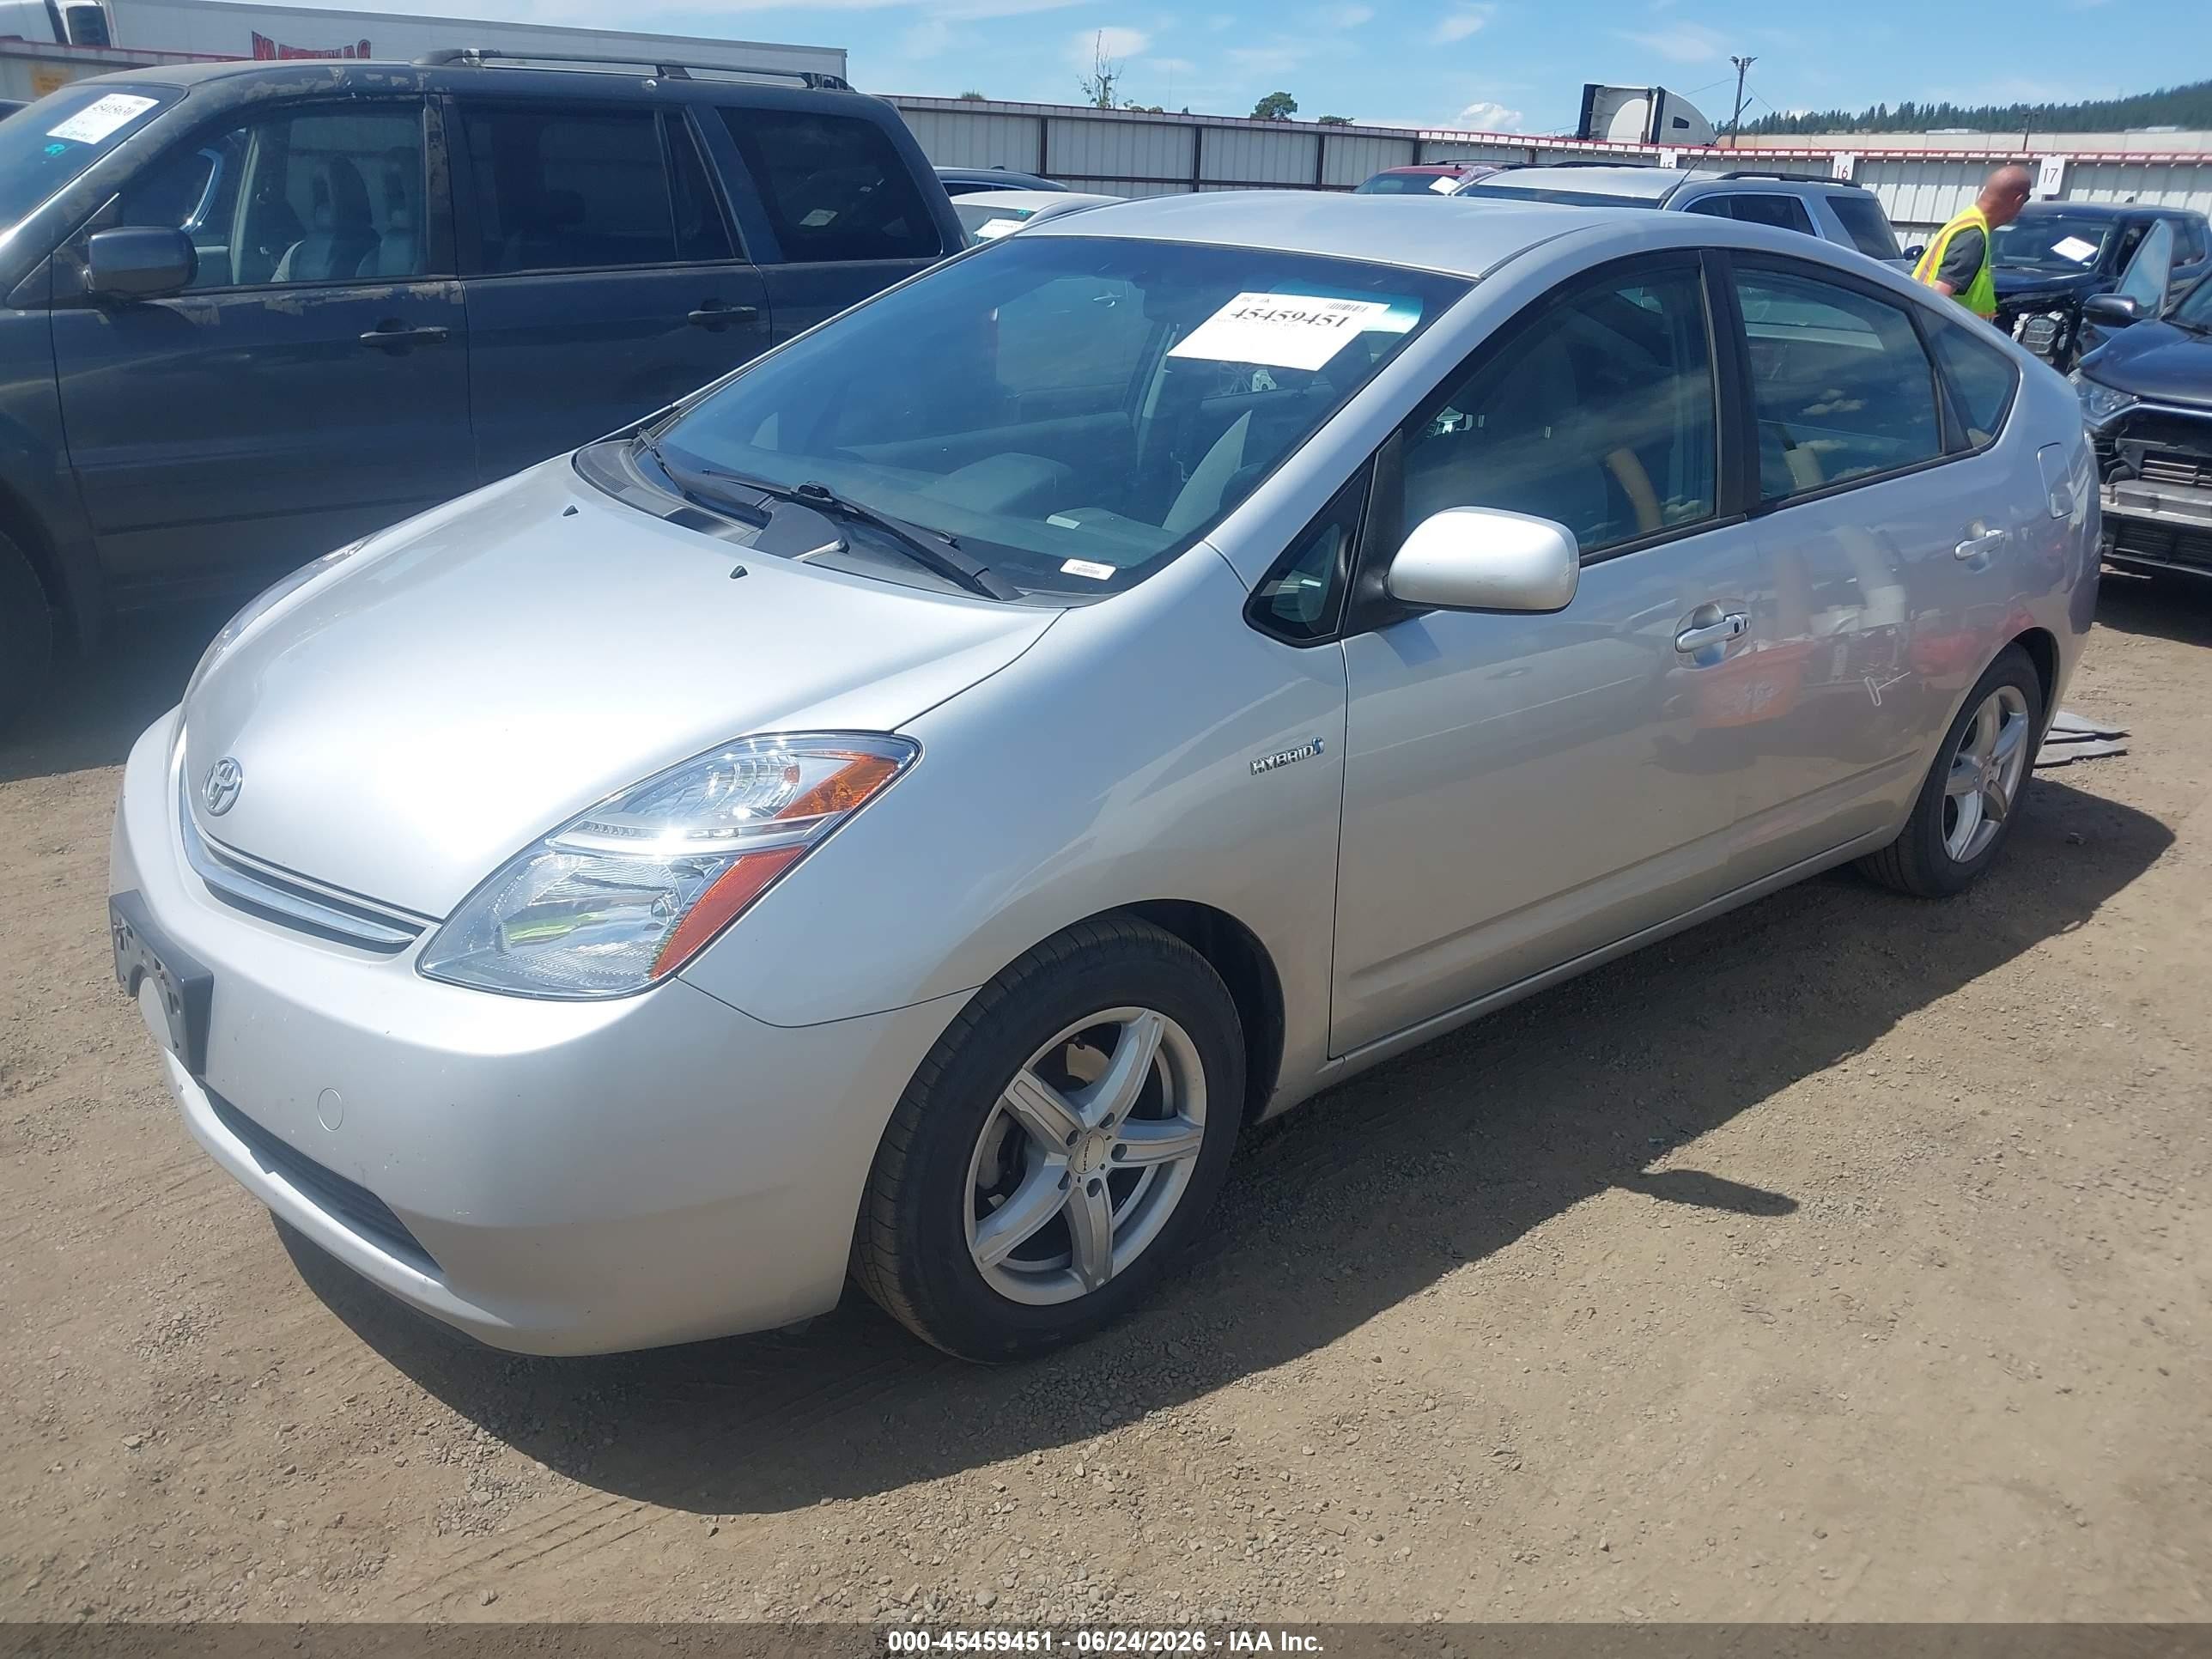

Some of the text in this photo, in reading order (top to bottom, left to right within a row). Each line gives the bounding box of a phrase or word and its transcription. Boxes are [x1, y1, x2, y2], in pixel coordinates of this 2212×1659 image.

[1836, 164, 1849, 179] 16
[2043, 167, 2059, 185] 17
[1229, 307, 1350, 327] 45459451
[1250, 744, 1314, 775] HYBRID
